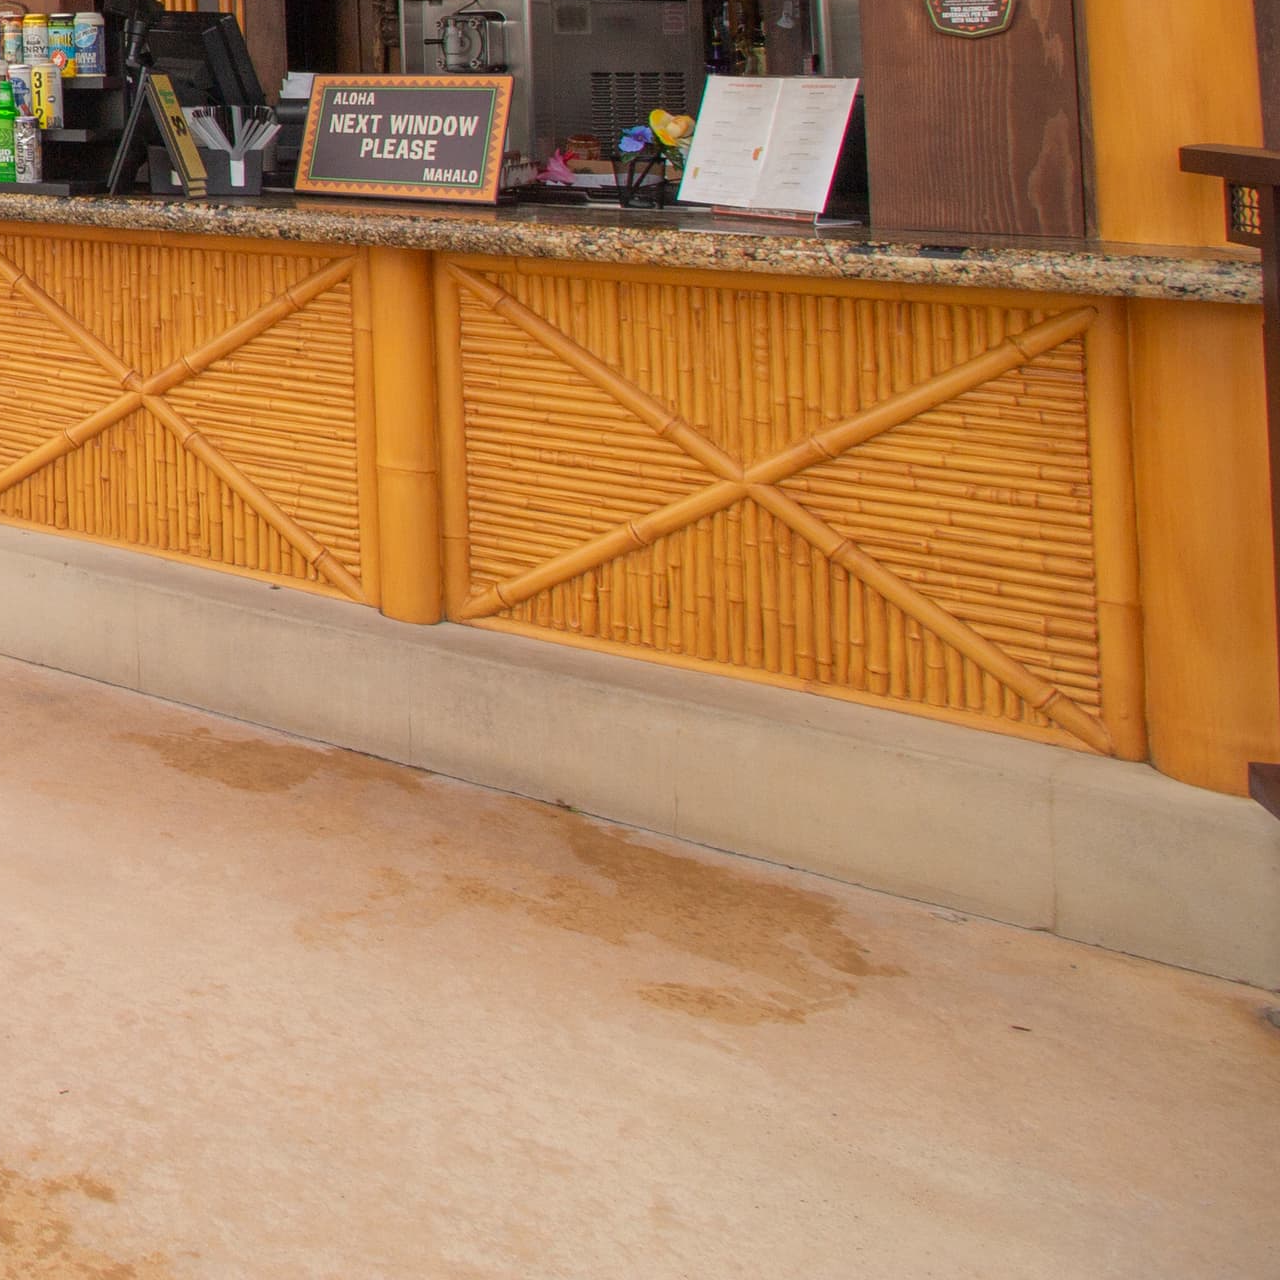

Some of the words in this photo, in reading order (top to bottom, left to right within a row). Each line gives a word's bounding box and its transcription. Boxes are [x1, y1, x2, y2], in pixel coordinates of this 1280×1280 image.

[33, 71, 45, 125] 312
[333, 92, 375, 105] ALOHA
[329, 114, 382, 134] NEXT
[390, 114, 479, 136] WINDOW
[359, 138, 438, 160] PLEASE
[422, 168, 478, 183] MAHALO
